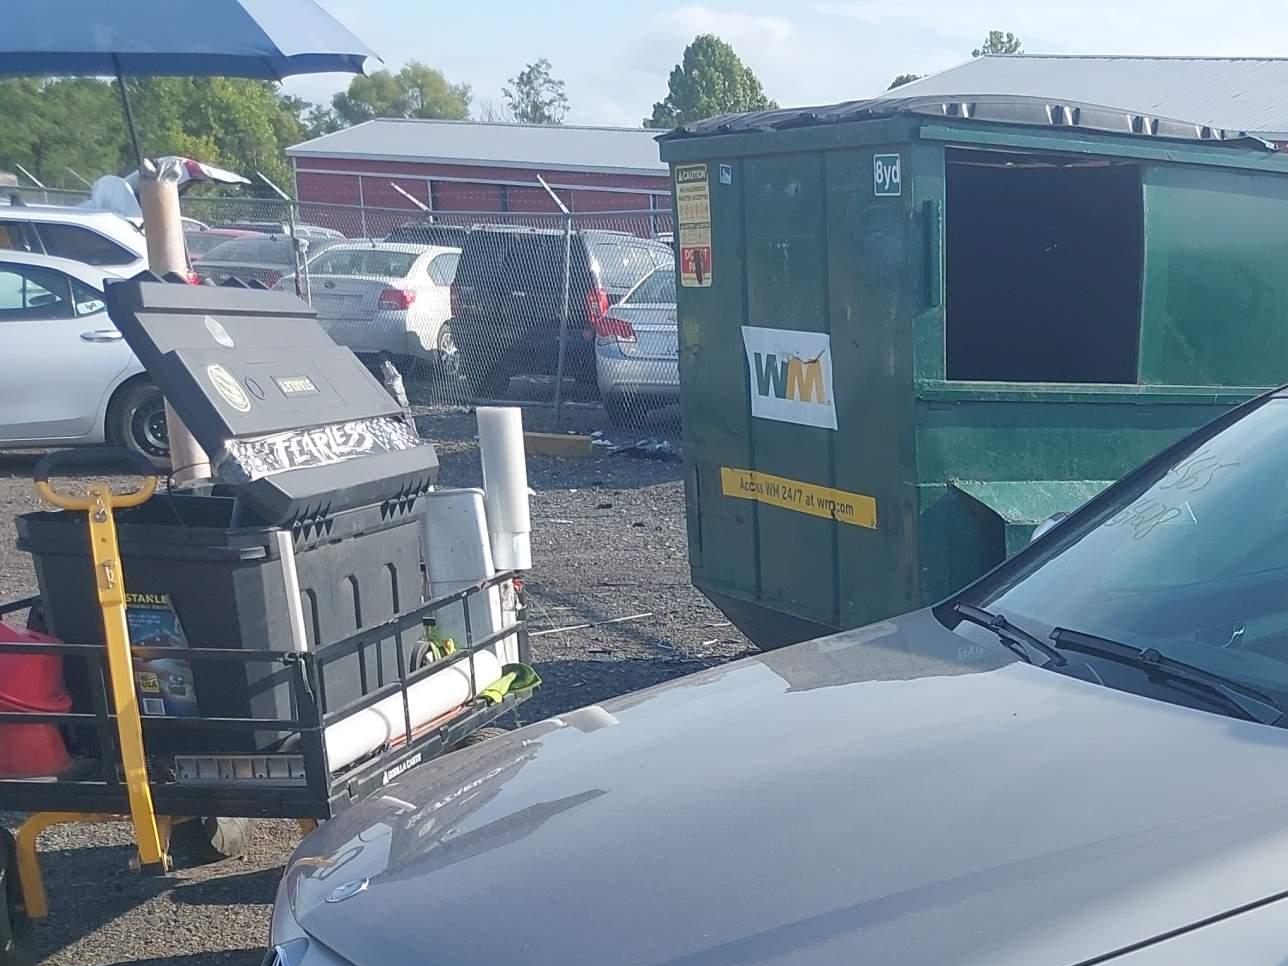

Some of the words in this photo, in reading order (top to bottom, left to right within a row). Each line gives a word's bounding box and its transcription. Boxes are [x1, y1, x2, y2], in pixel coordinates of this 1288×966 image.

[875, 160, 900, 190] 8yd
[753, 352, 826, 405] WM
[766, 481, 780, 498] WM
[782, 485, 803, 504] 24/7
[806, 493, 815, 506] at
